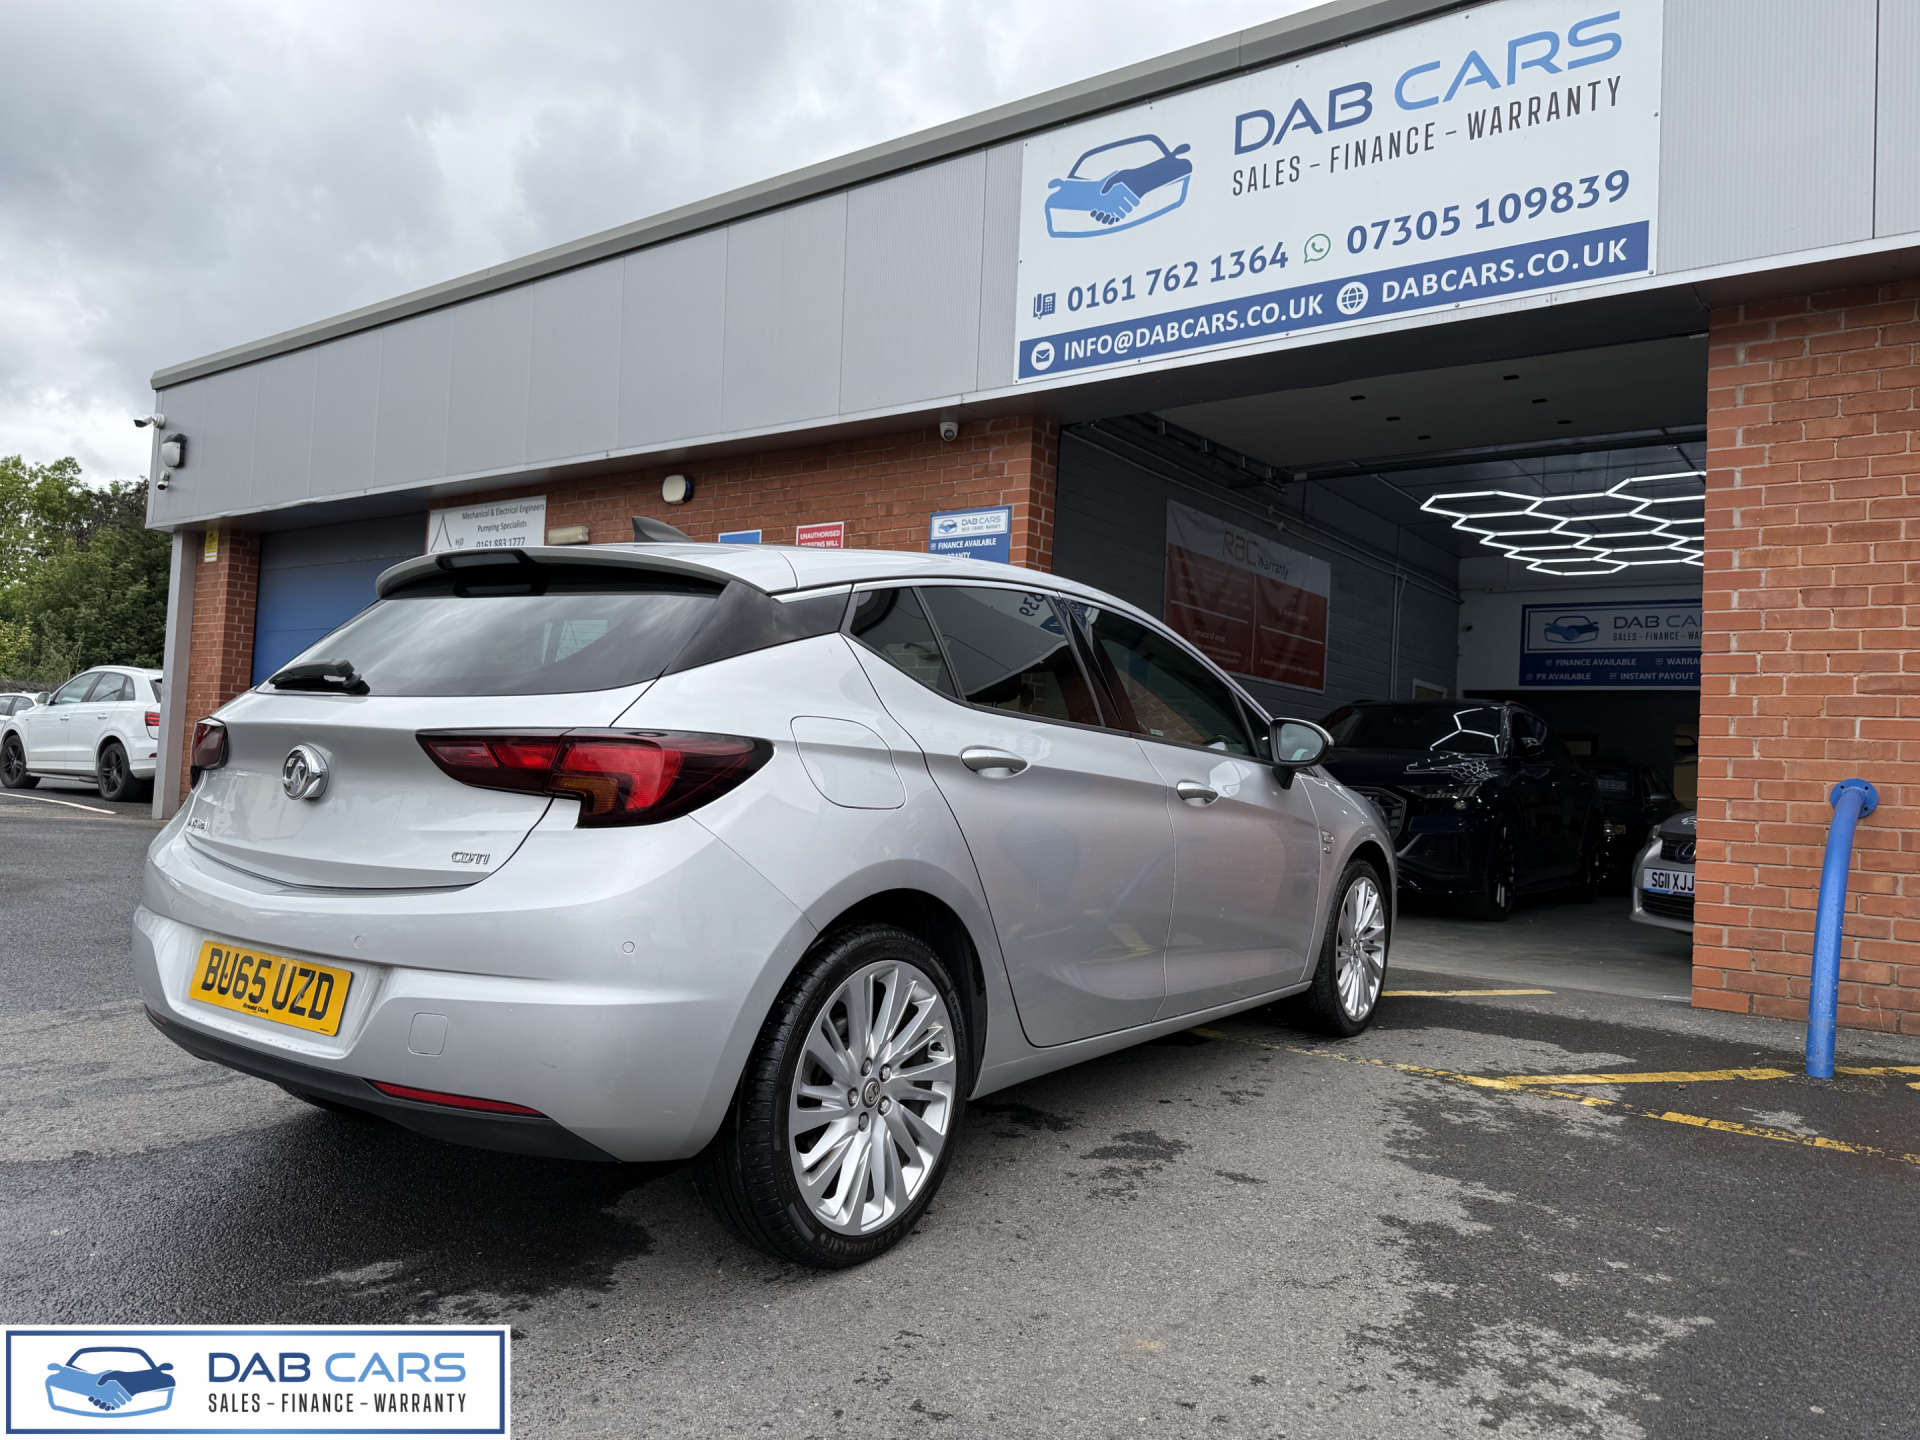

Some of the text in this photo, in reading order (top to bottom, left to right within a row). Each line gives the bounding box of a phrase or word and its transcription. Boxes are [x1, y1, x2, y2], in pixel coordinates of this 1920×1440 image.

[1233, 10, 1622, 156] DAB CARS
[1232, 155, 1301, 196] SALES
[1329, 122, 1436, 173] FINANCE
[1467, 75, 1622, 140] WARRANTY
[1347, 169, 1630, 254] 07305 109839
[1067, 241, 1289, 312] 0161 762 1364
[1381, 237, 1628, 303] DABCARS.CO.UK
[1063, 293, 1324, 362] INFO@DABCARS.CO.UK
[938, 537, 997, 551] FINANCE AVAILABLE
[1613, 615, 1698, 629] DAB CA
[201, 947, 335, 1021] BU65 UZD
